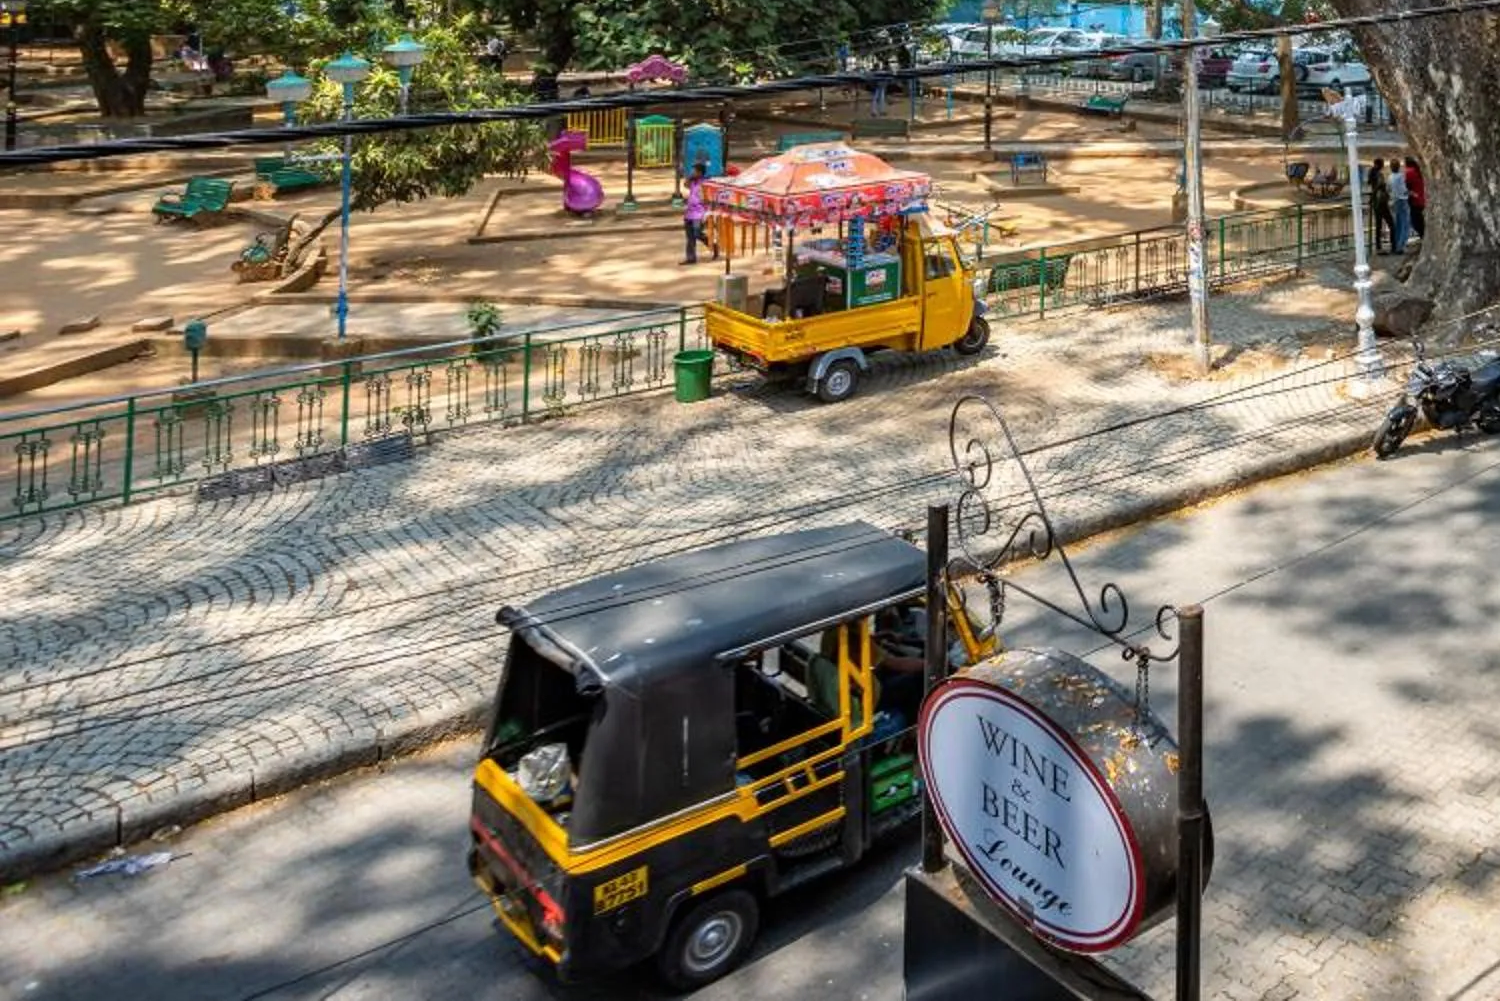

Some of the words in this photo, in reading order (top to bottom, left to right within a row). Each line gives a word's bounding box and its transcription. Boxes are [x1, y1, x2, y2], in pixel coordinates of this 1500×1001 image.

[977, 715, 1071, 802] WINE
[1010, 777, 1033, 803] &
[981, 781, 1065, 869] BEER
[975, 828, 1073, 917] Lounge
